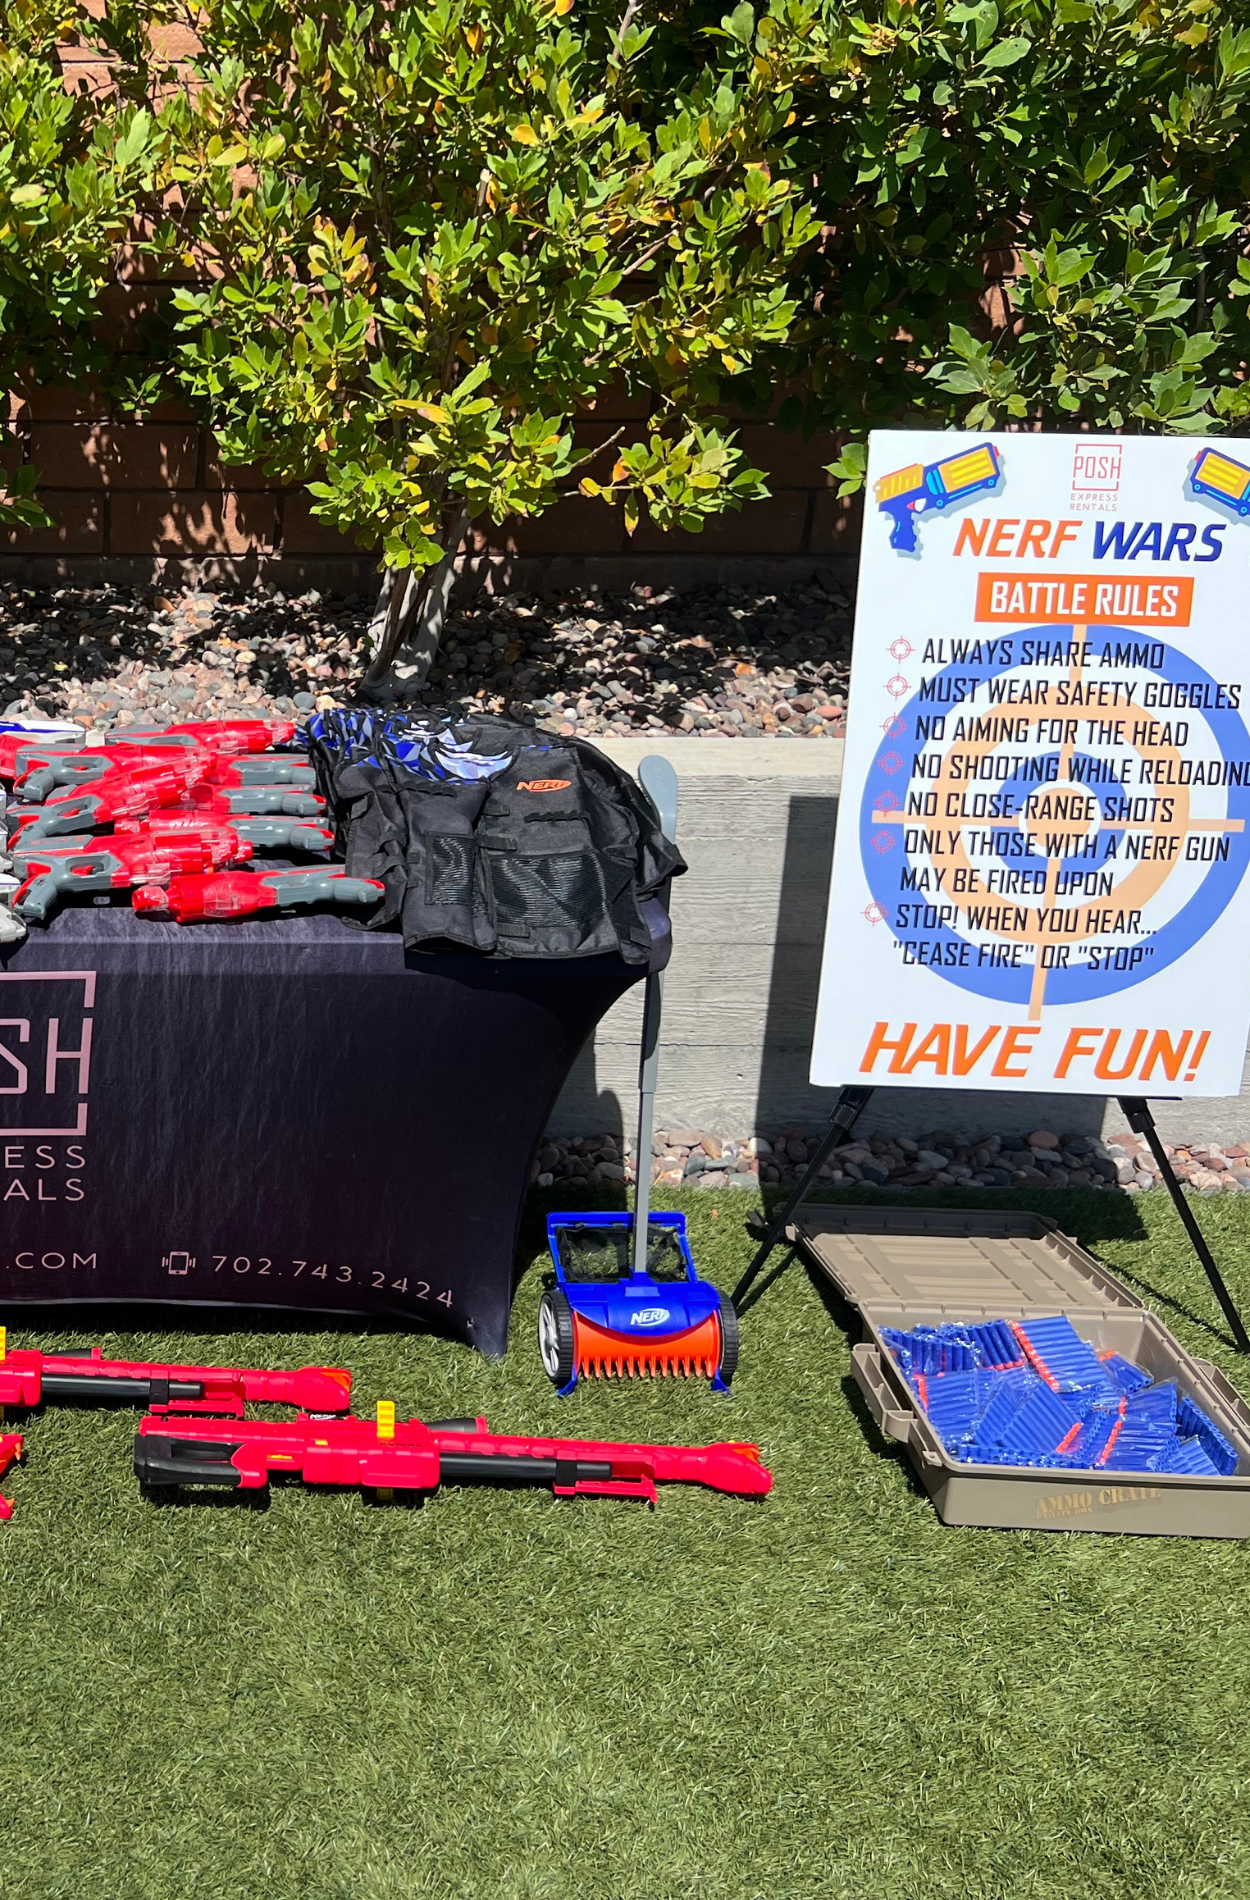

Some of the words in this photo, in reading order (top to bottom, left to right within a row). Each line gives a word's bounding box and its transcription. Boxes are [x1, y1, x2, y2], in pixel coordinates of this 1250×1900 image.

[1073, 456, 1120, 480] POSH
[1070, 503, 1117, 512] RENTALS
[1071, 493, 1118, 502] EXPRESS
[952, 518, 1082, 558] NERF
[1093, 521, 1226, 562] WARS
[990, 581, 1088, 615] BATTLE
[1095, 583, 1178, 617] RULES
[922, 638, 1013, 665] ALWAYS
[1020, 640, 1092, 667] SHARE
[1099, 642, 1164, 669] AMMO
[919, 676, 980, 703] MUST
[988, 678, 1049, 705] WEAR
[1057, 680, 1138, 707] SAFETY
[1144, 683, 1241, 710] GOGGLES
[916, 715, 946, 741] NO
[952, 716, 1029, 742] AIMING
[1036, 719, 1079, 744] FOR
[1087, 720, 1126, 745] THE
[1132, 721, 1188, 746] HEAD
[911, 754, 941, 778] NO
[950, 755, 1059, 782] SHOOTING
[1068, 758, 1131, 783] WHILE
[516, 779, 572, 792] NERF
[908, 791, 937, 816] NO
[945, 793, 1097, 820] CLOSE-RANGE
[1103, 797, 1174, 822] SHOTS
[904, 830, 960, 855] ONLY
[969, 832, 1037, 857] THOSE
[1045, 834, 1098, 859] WITH
[1104, 835, 1117, 860] A
[1125, 836, 1181, 860] NERF
[1186, 837, 1230, 862] GUN
[900, 867, 947, 891] MAY
[953, 869, 978, 892] BE
[987, 870, 1047, 895] FIRED
[1055, 872, 1114, 896] UPON
[896, 905, 958, 929] STOP!
[967, 907, 1027, 931] WHEN
[1036, 909, 1080, 933] YOU
[1085, 910, 1157, 934] HEAR...
[893, 941, 971, 966] "CEASE
[978, 943, 1035, 968] FIRE"
[1041, 946, 1069, 969] OR
[1078, 946, 1154, 971] "STOP"
[859, 1022, 1041, 1077] HAVE
[1054, 1027, 1211, 1081] FUN!
[212, 1255, 453, 1308] 702.743.2424
[630, 1308, 670, 1326] NERF
[1037, 1492, 1093, 1512] AMMO
[1098, 1487, 1161, 1505] CRATE
